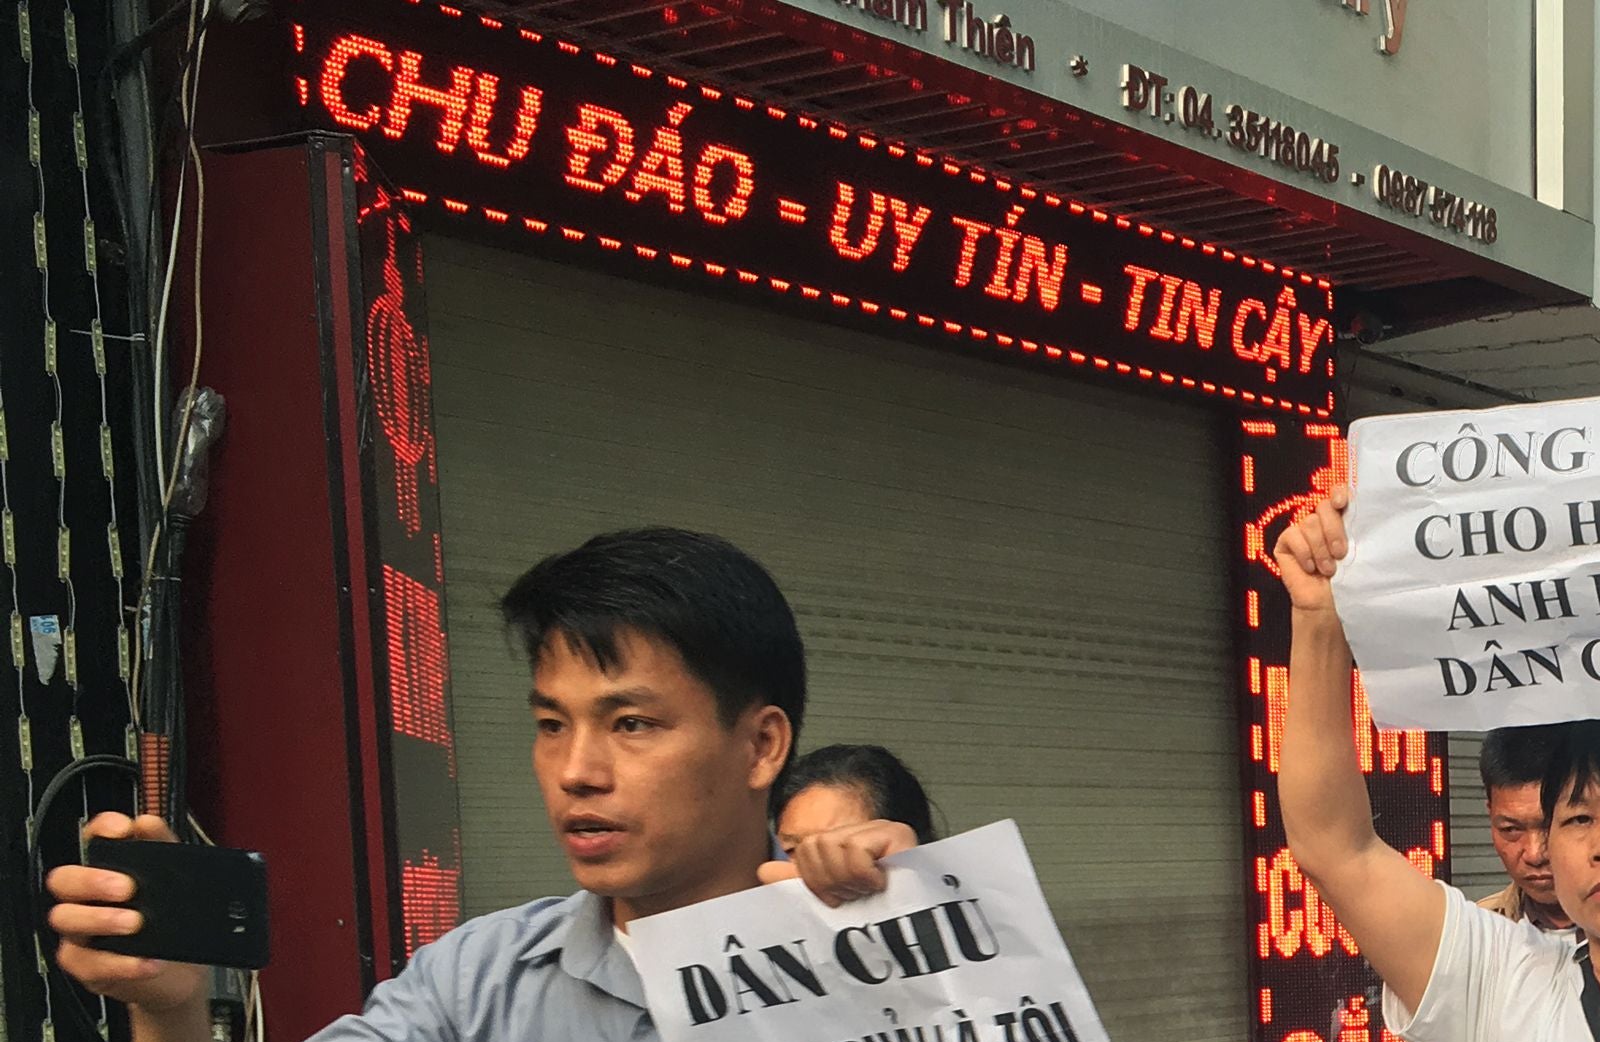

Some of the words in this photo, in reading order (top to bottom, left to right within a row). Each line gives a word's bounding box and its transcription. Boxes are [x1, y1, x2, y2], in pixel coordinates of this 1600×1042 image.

[321, 35, 543, 168] CHU
[563, 102, 754, 223] ĐÁO
[829, 181, 931, 272] UY
[952, 204, 1068, 312] TÍN
[1124, 265, 1222, 349] TIN
[1231, 284, 1329, 383] CẬY
[1396, 423, 1590, 488] CÔNG
[1415, 506, 1547, 560] CHO
[1446, 576, 1579, 632] ANH
[1434, 640, 1564, 697] DÂN
[676, 934, 829, 1026] DÂN
[833, 874, 1000, 985] CHỦ
